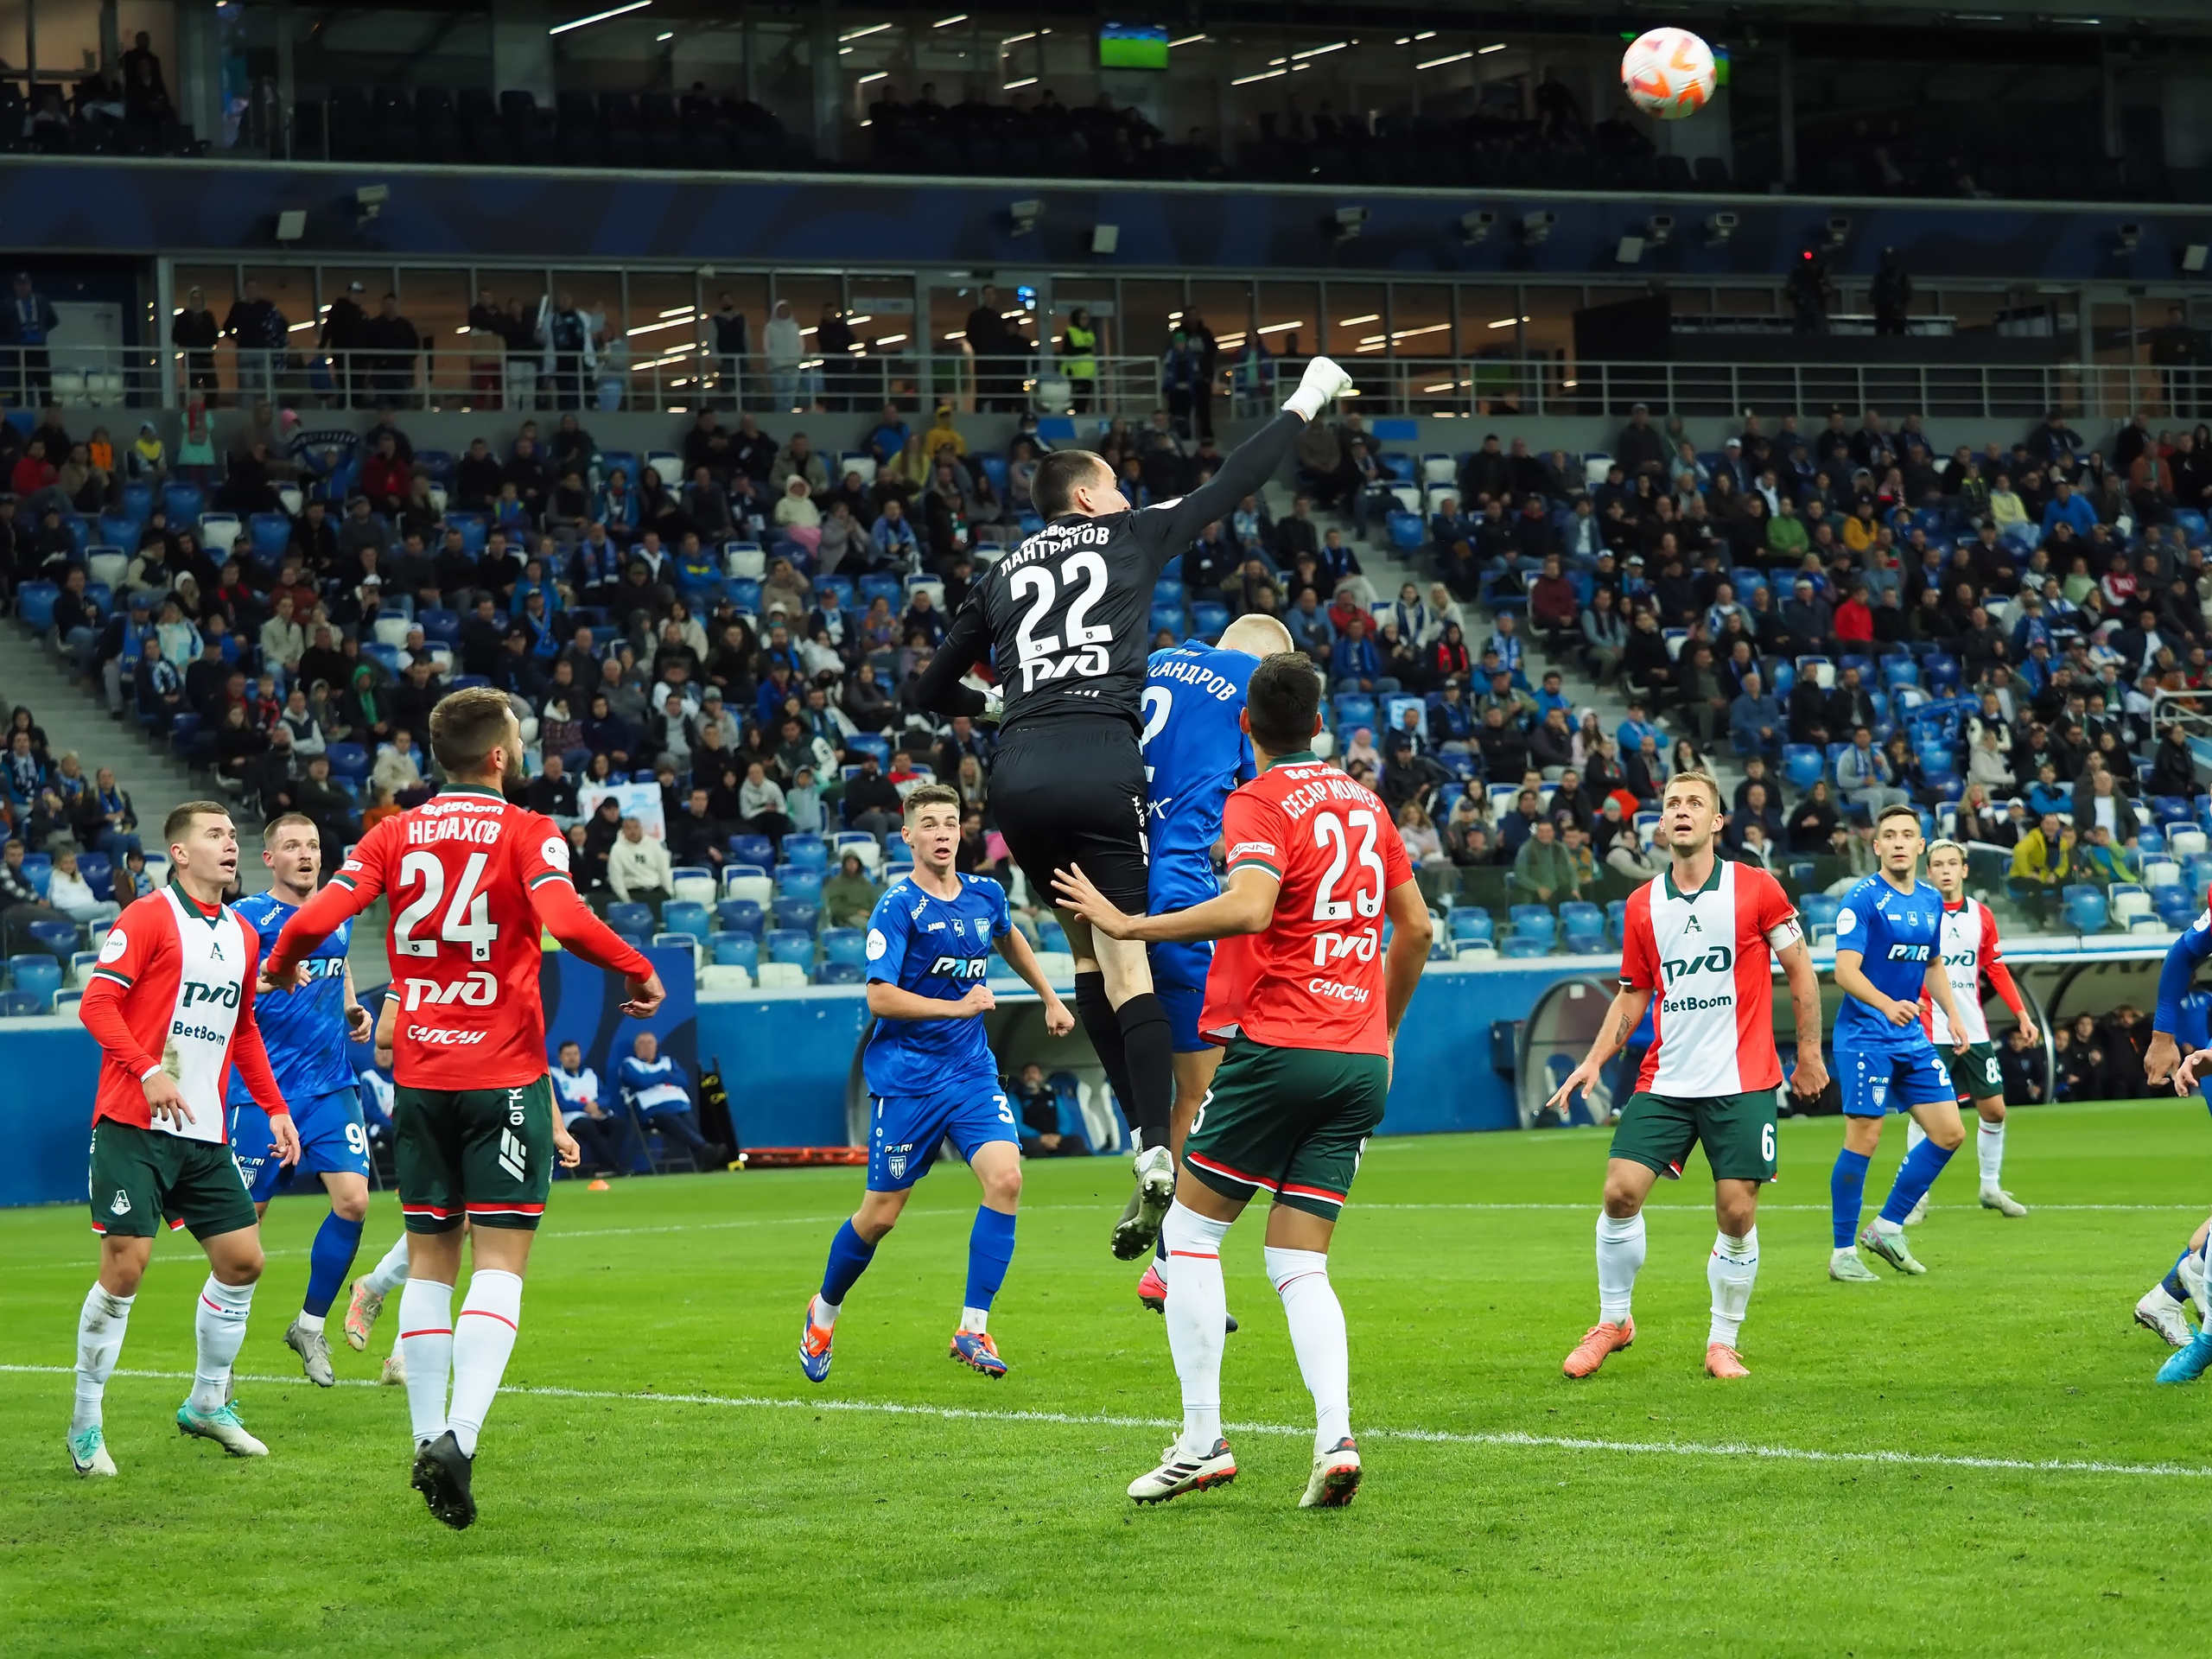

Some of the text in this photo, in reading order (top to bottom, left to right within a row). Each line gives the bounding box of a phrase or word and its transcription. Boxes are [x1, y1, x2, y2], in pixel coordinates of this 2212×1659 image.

[1001, 527, 1109, 577] ЛАНТРАТОВ
[1009, 551, 1114, 663] 22
[1281, 781, 1328, 820] СЕСАР
[409, 817, 501, 844] НЕНАХОВ
[1313, 810, 1384, 921] 23
[394, 850, 499, 962] 24
[931, 957, 987, 978] PARI
[1887, 944, 1930, 961] PAR
[1663, 995, 1732, 1013] BetBoom
[508, 1088, 524, 1125] ФГК
[238, 1155, 265, 1166] PARI
[884, 1143, 913, 1154] PARI
[1761, 1122, 1776, 1162] 6
